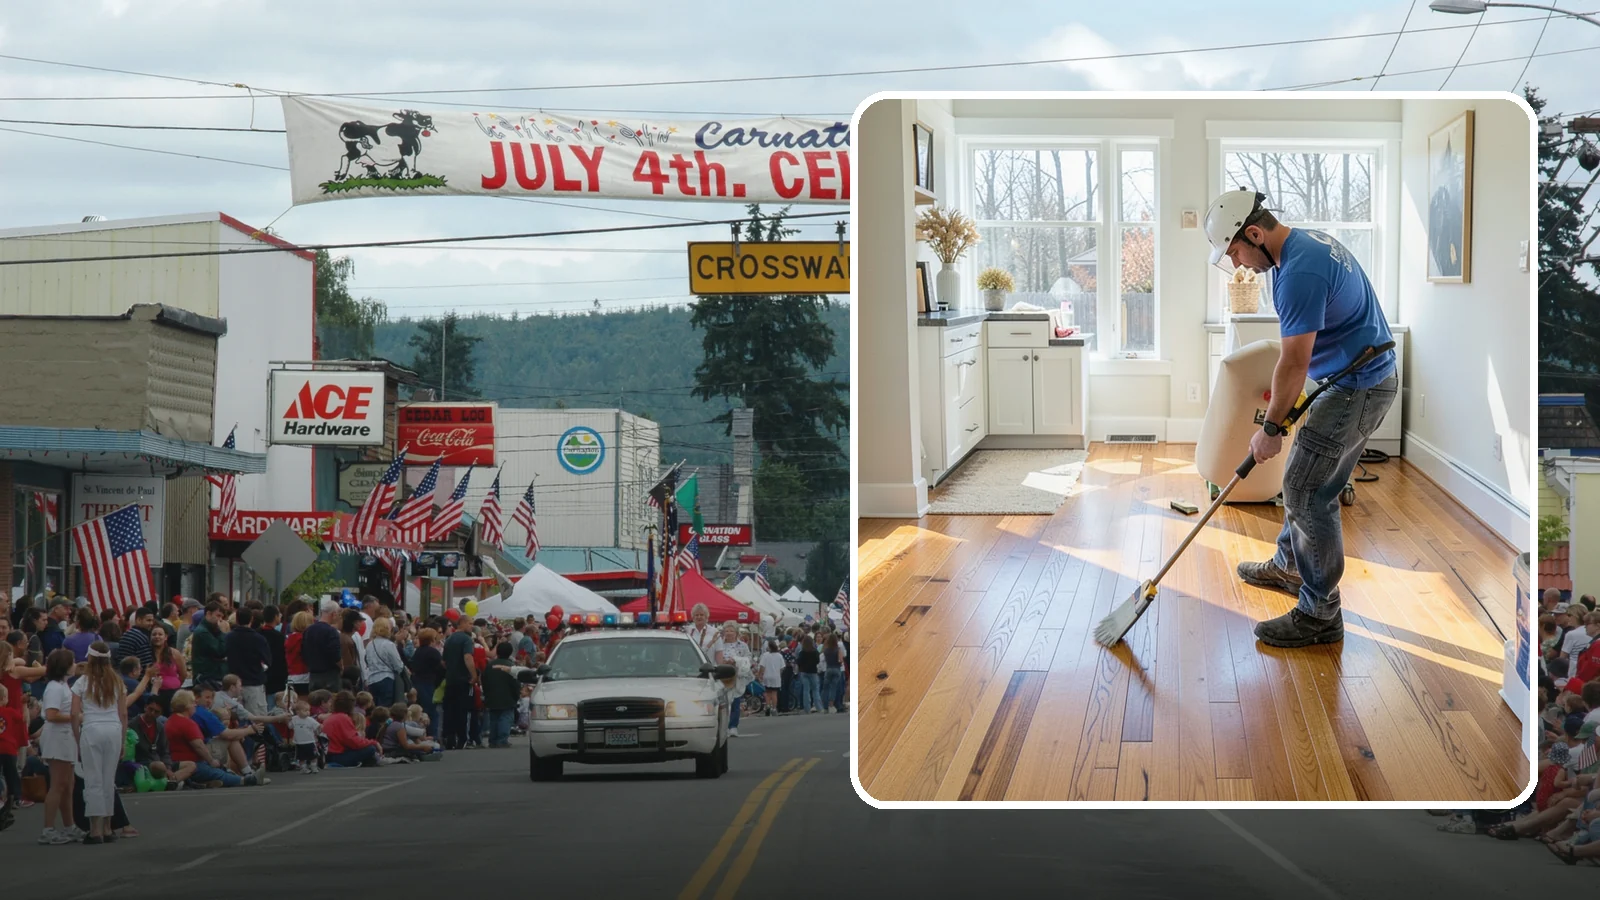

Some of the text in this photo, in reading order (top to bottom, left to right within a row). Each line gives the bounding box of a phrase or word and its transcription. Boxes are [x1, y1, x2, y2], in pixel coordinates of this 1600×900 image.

[694, 121, 850, 150] Carnat
[481, 141, 605, 192] JULY
[632, 150, 747, 198] 4th.
[697, 254, 850, 280] CROSSWA
[283, 380, 373, 420] ACE
[405, 409, 452, 422] CEDAR
[283, 421, 371, 437] Hardware
[416, 428, 477, 447] Coca-Cola
[96, 485, 124, 495] Vincent
[126, 486, 136, 495] de
[138, 486, 155, 495] Paul
[699, 535, 730, 543] GLASS
